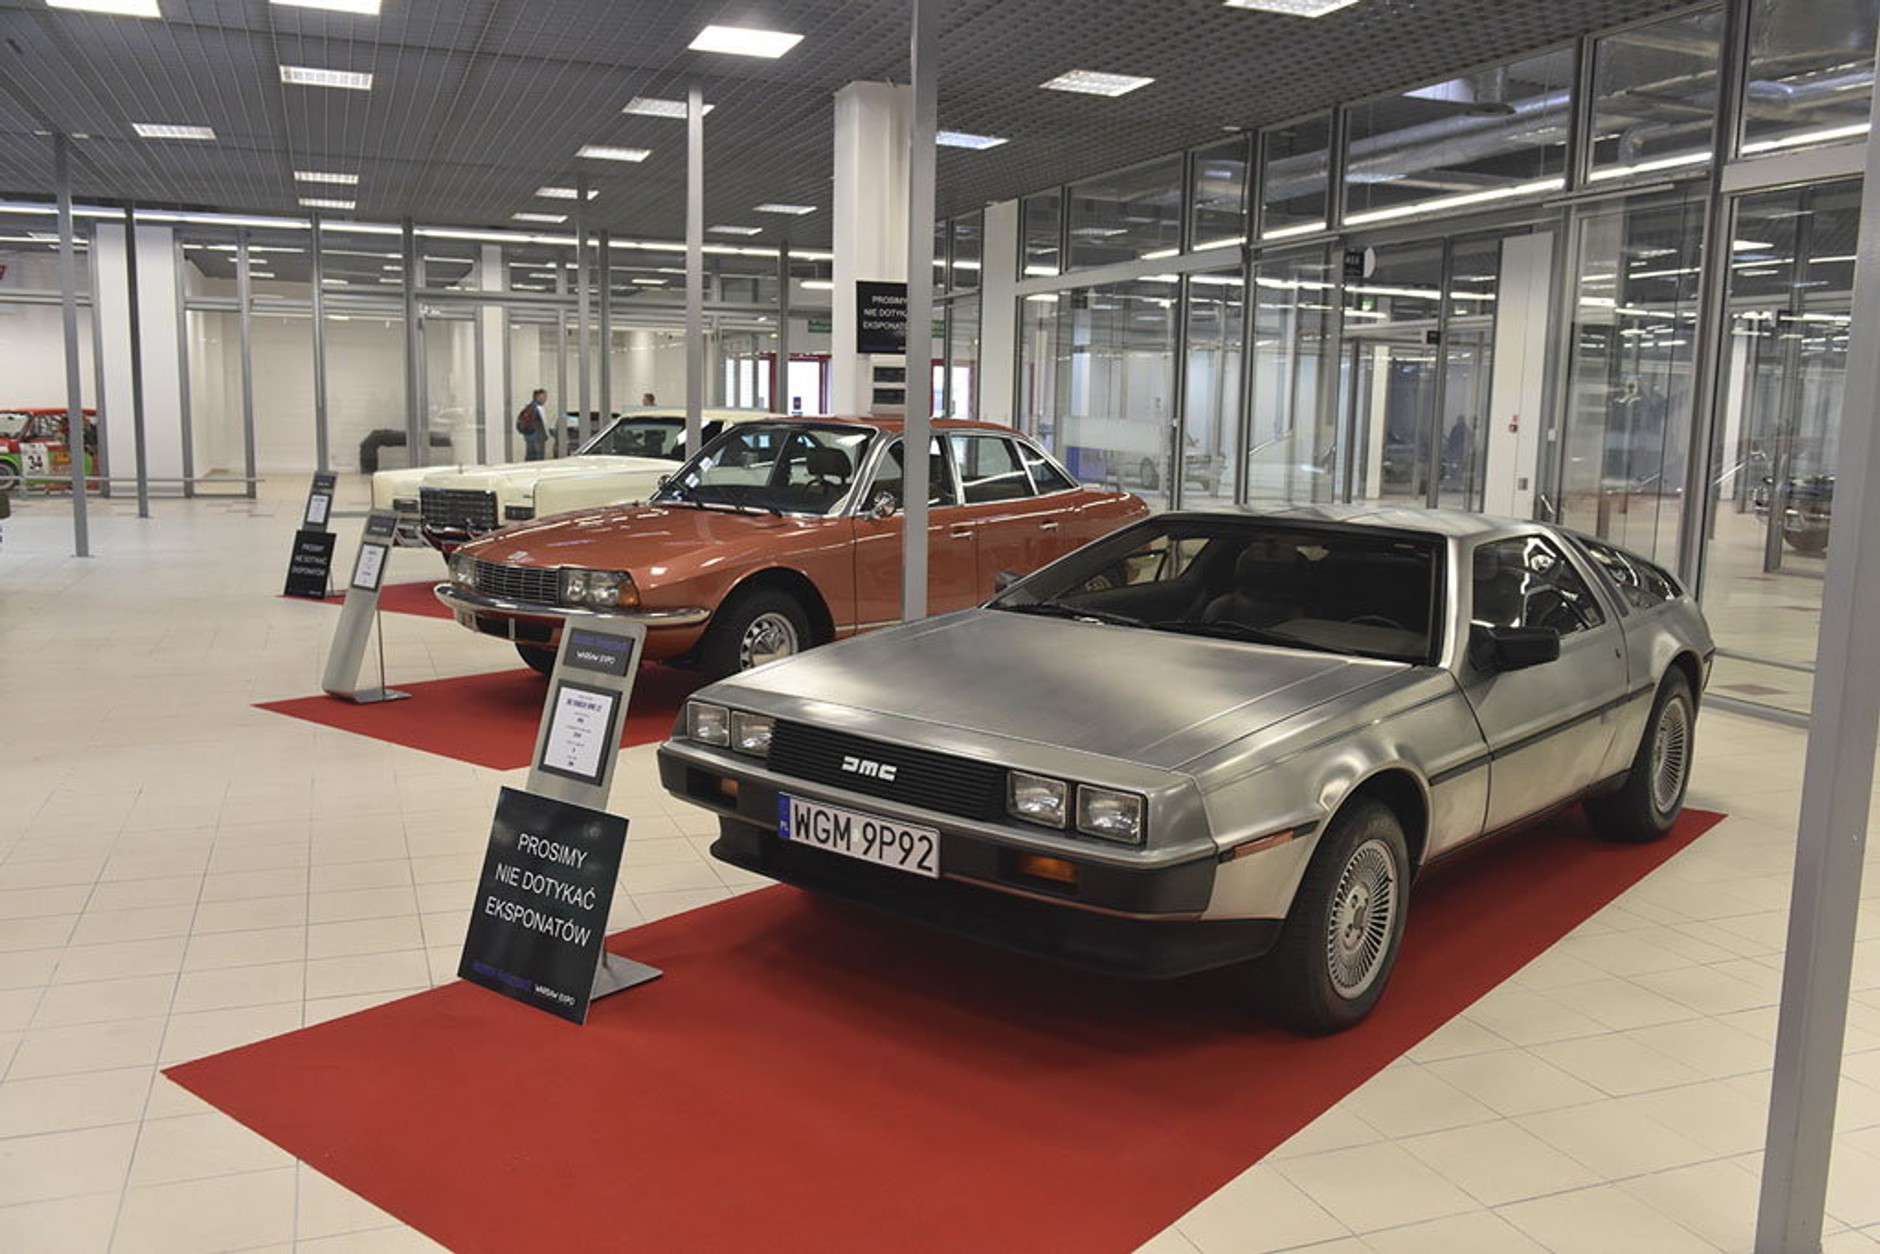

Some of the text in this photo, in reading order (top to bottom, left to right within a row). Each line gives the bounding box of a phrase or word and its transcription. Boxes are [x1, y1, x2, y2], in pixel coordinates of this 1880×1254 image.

[879, 309, 908, 317] DOTYK
[27, 455, 43, 469] 34
[517, 833, 588, 869] PROSIMY
[794, 803, 934, 873] WGM 9P92
[495, 862, 597, 911] NIE DOTYKAĆ
[484, 896, 592, 947] EKSPONATÓW
